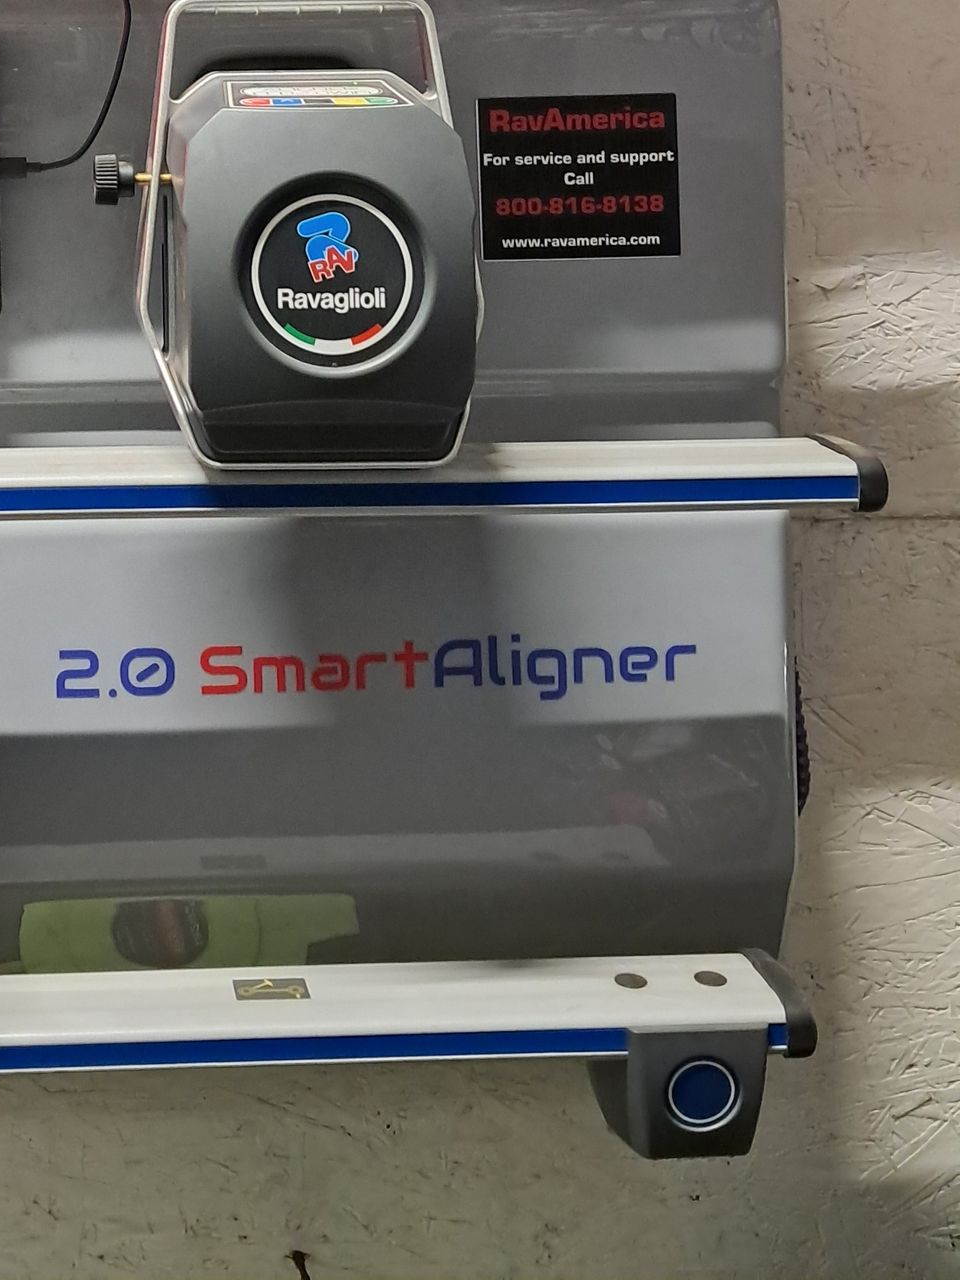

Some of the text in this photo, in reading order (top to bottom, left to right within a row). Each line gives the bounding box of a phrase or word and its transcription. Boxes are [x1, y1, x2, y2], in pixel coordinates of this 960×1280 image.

[489, 106, 666, 133] RavAmerica
[483, 150, 675, 166] For service and support
[563, 171, 594, 186] Call
[495, 194, 665, 216] 800-816-8138
[501, 233, 661, 249] www.ravamerica.com
[307, 245, 356, 283] RAV
[276, 286, 387, 314] Ravaglioli
[55, 646, 176, 700] 2.0
